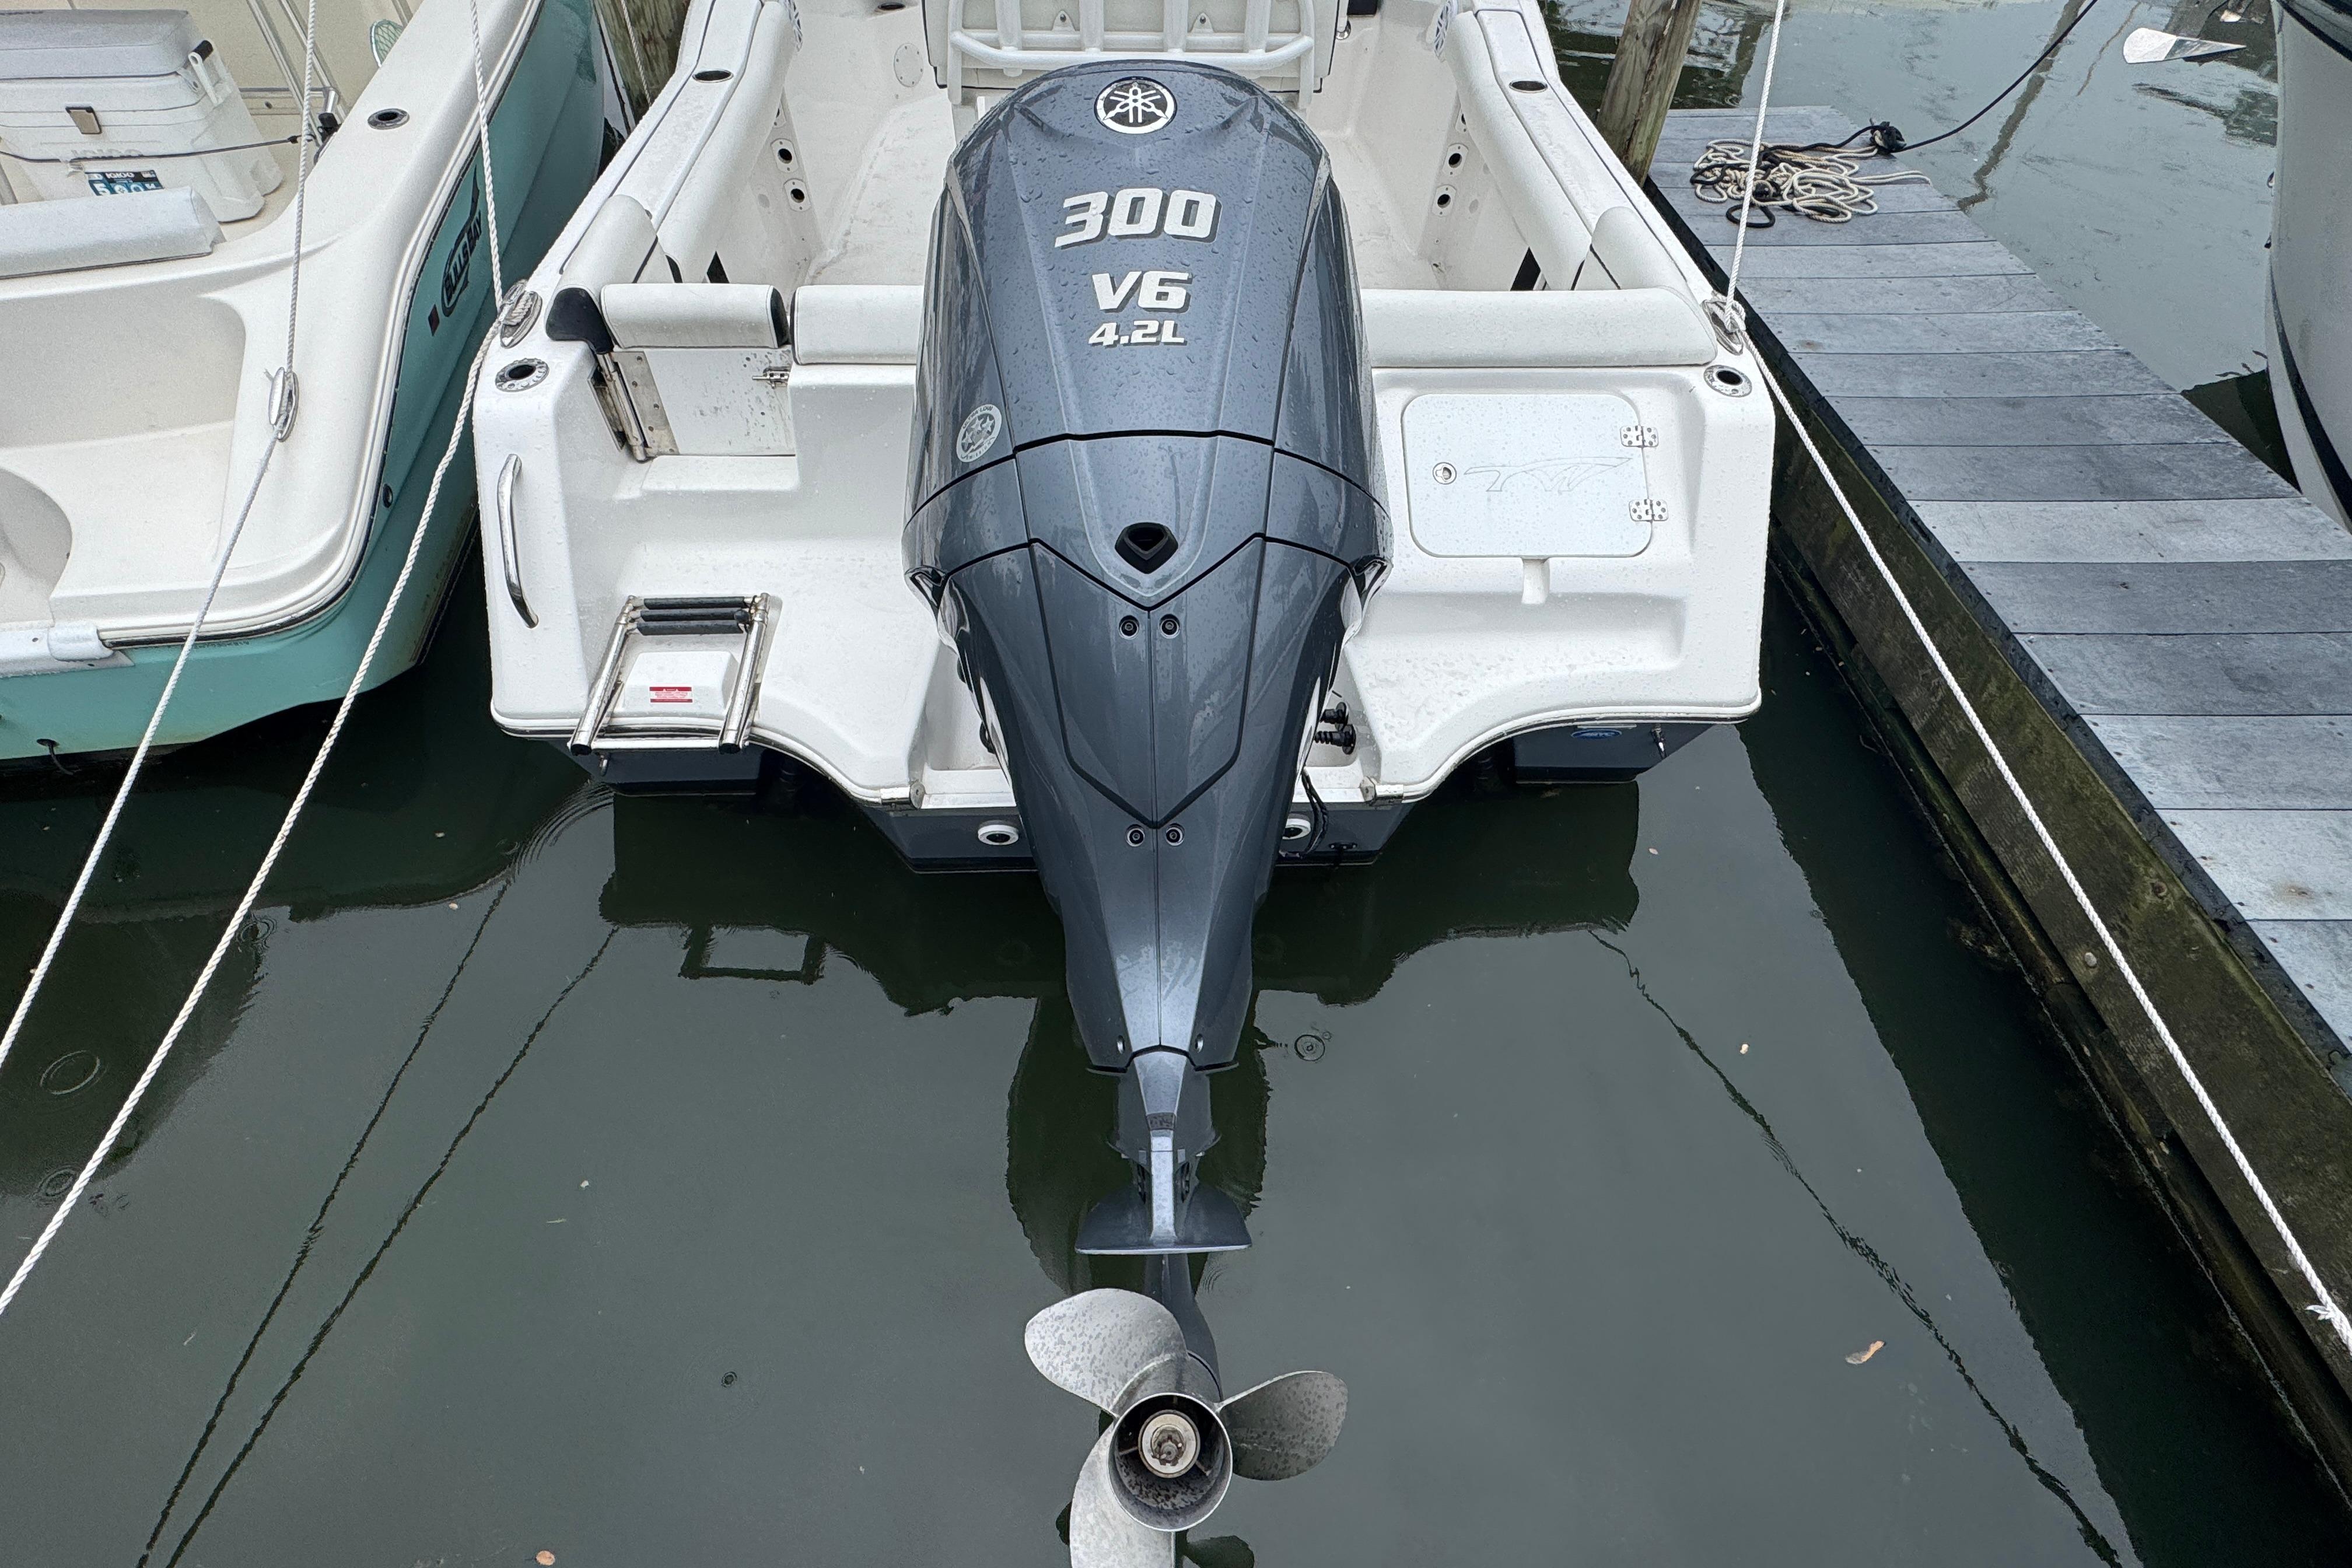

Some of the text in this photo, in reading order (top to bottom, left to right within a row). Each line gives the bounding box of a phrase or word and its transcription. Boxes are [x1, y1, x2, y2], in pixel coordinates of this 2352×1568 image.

[1054, 188, 1222, 249] 300
[1092, 271, 1192, 313] V6
[1088, 320, 1188, 347] 4.2L
